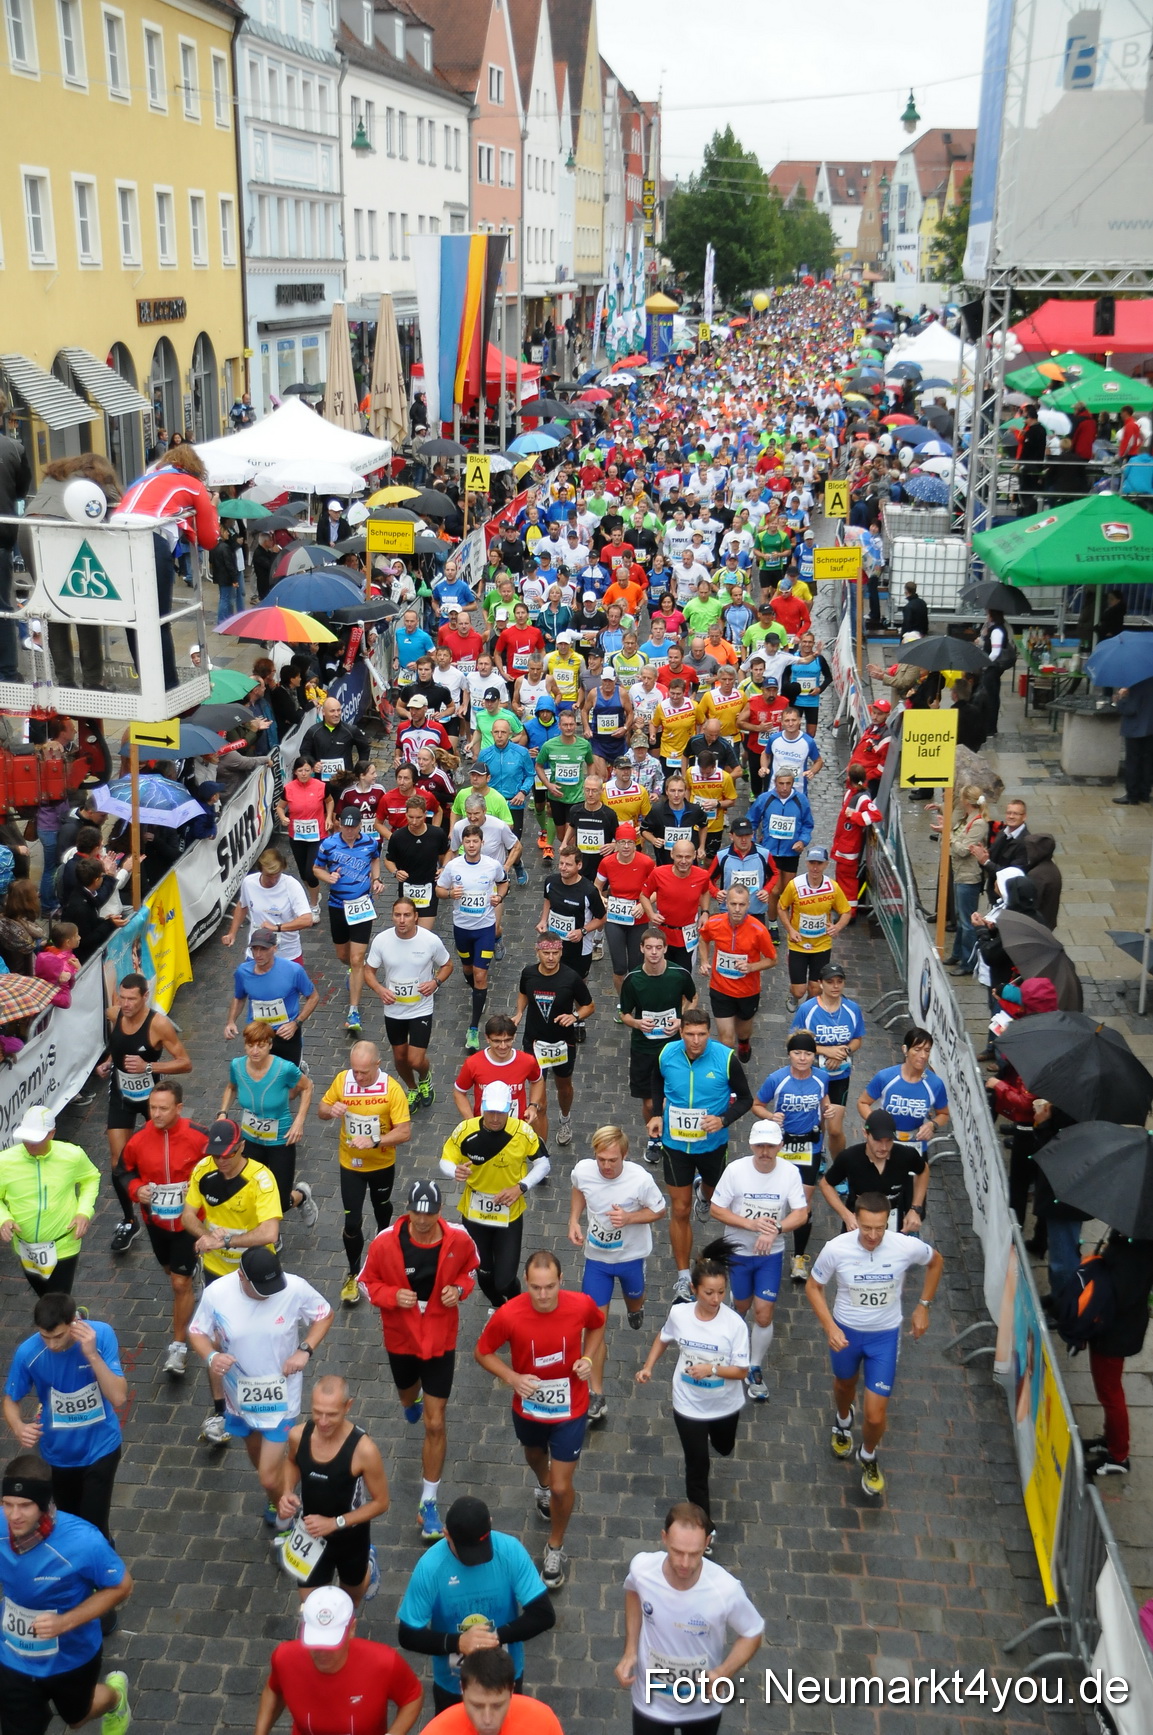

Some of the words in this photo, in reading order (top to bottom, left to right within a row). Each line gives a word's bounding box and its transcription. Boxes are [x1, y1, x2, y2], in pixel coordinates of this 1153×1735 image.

[644, 181, 655, 247] HOTEL
[470, 455, 488, 464] Block
[471, 466, 484, 483] A
[828, 482, 848, 490] Block
[831, 492, 844, 509] A
[370, 529, 411, 539] Schnupper-
[816, 557, 858, 565] Schnupper-
[830, 565, 843, 573] lauf
[557, 673, 570, 681] 565
[623, 678, 635, 686] 560
[601, 719, 615, 727] 388
[905, 731, 955, 746] Jugend-
[918, 746, 941, 758] lauf
[557, 767, 578, 778] 2595
[296, 824, 316, 834] 3151
[772, 820, 793, 831] 2987
[582, 835, 599, 845] 263
[333, 850, 369, 871] TEAM
[409, 889, 426, 899] 282
[461, 897, 485, 907] 2243
[799, 898, 816, 907] MAX
[610, 903, 633, 915] 2547
[550, 917, 572, 932] 2528
[802, 919, 825, 930] 2845
[395, 985, 413, 997] 537
[259, 1006, 278, 1017] 111
[541, 1047, 561, 1058] 519
[122, 1077, 151, 1092] 2086
[365, 1097, 389, 1106] BÖGL
[249, 1117, 271, 1133] 275
[677, 1116, 700, 1129] 167
[349, 1121, 372, 1136] 513
[678, 1130, 698, 1139] Maurice
[152, 1191, 184, 1206] 2771
[206, 1193, 219, 1203] Peter
[478, 1199, 502, 1213] 195
[591, 1223, 622, 1243] 2438
[860, 1292, 888, 1306] 262
[242, 1386, 283, 1402] 2346
[528, 1388, 566, 1405] 2325
[55, 1393, 98, 1415] 2895
[251, 1404, 278, 1413] Michael
[68, 1413, 89, 1423] Heiko
